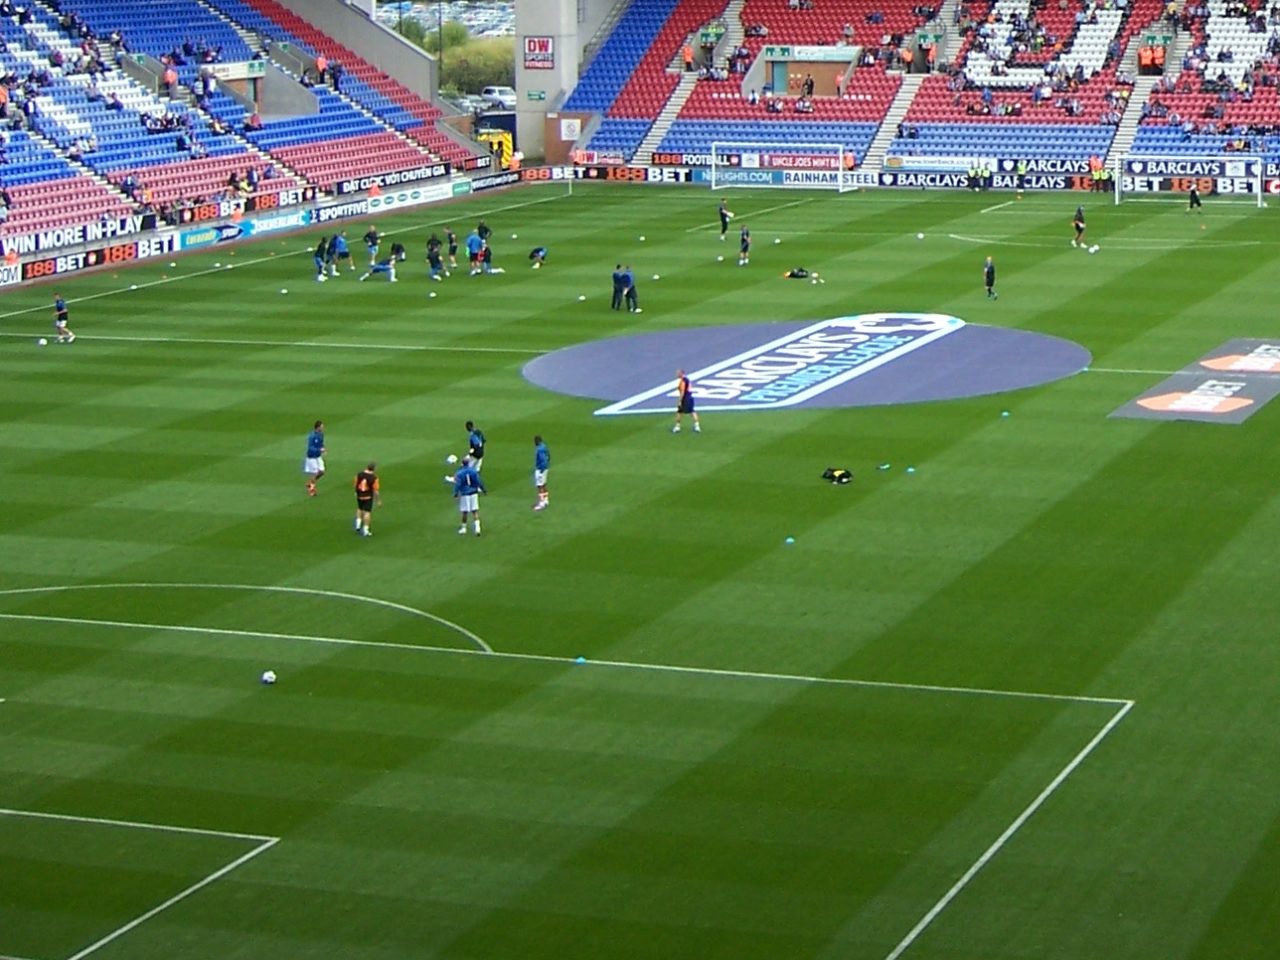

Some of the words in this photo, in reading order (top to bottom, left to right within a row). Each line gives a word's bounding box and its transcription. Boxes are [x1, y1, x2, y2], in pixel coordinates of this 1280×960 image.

[528, 39, 549, 52] DW
[1018, 160, 1090, 172] ARCLAYS
[1147, 161, 1221, 175] BARCLAYS
[785, 172, 839, 184] RAINHAM
[843, 173, 877, 185] STEEL
[897, 174, 969, 187] BARCLAYS
[319, 201, 368, 222] SPORTFIVE
[3, 235, 36, 256] WIN
[38, 226, 84, 250] MORE
[86, 215, 144, 241] IN-PLAY
[667, 332, 871, 401] BARCLAYS
